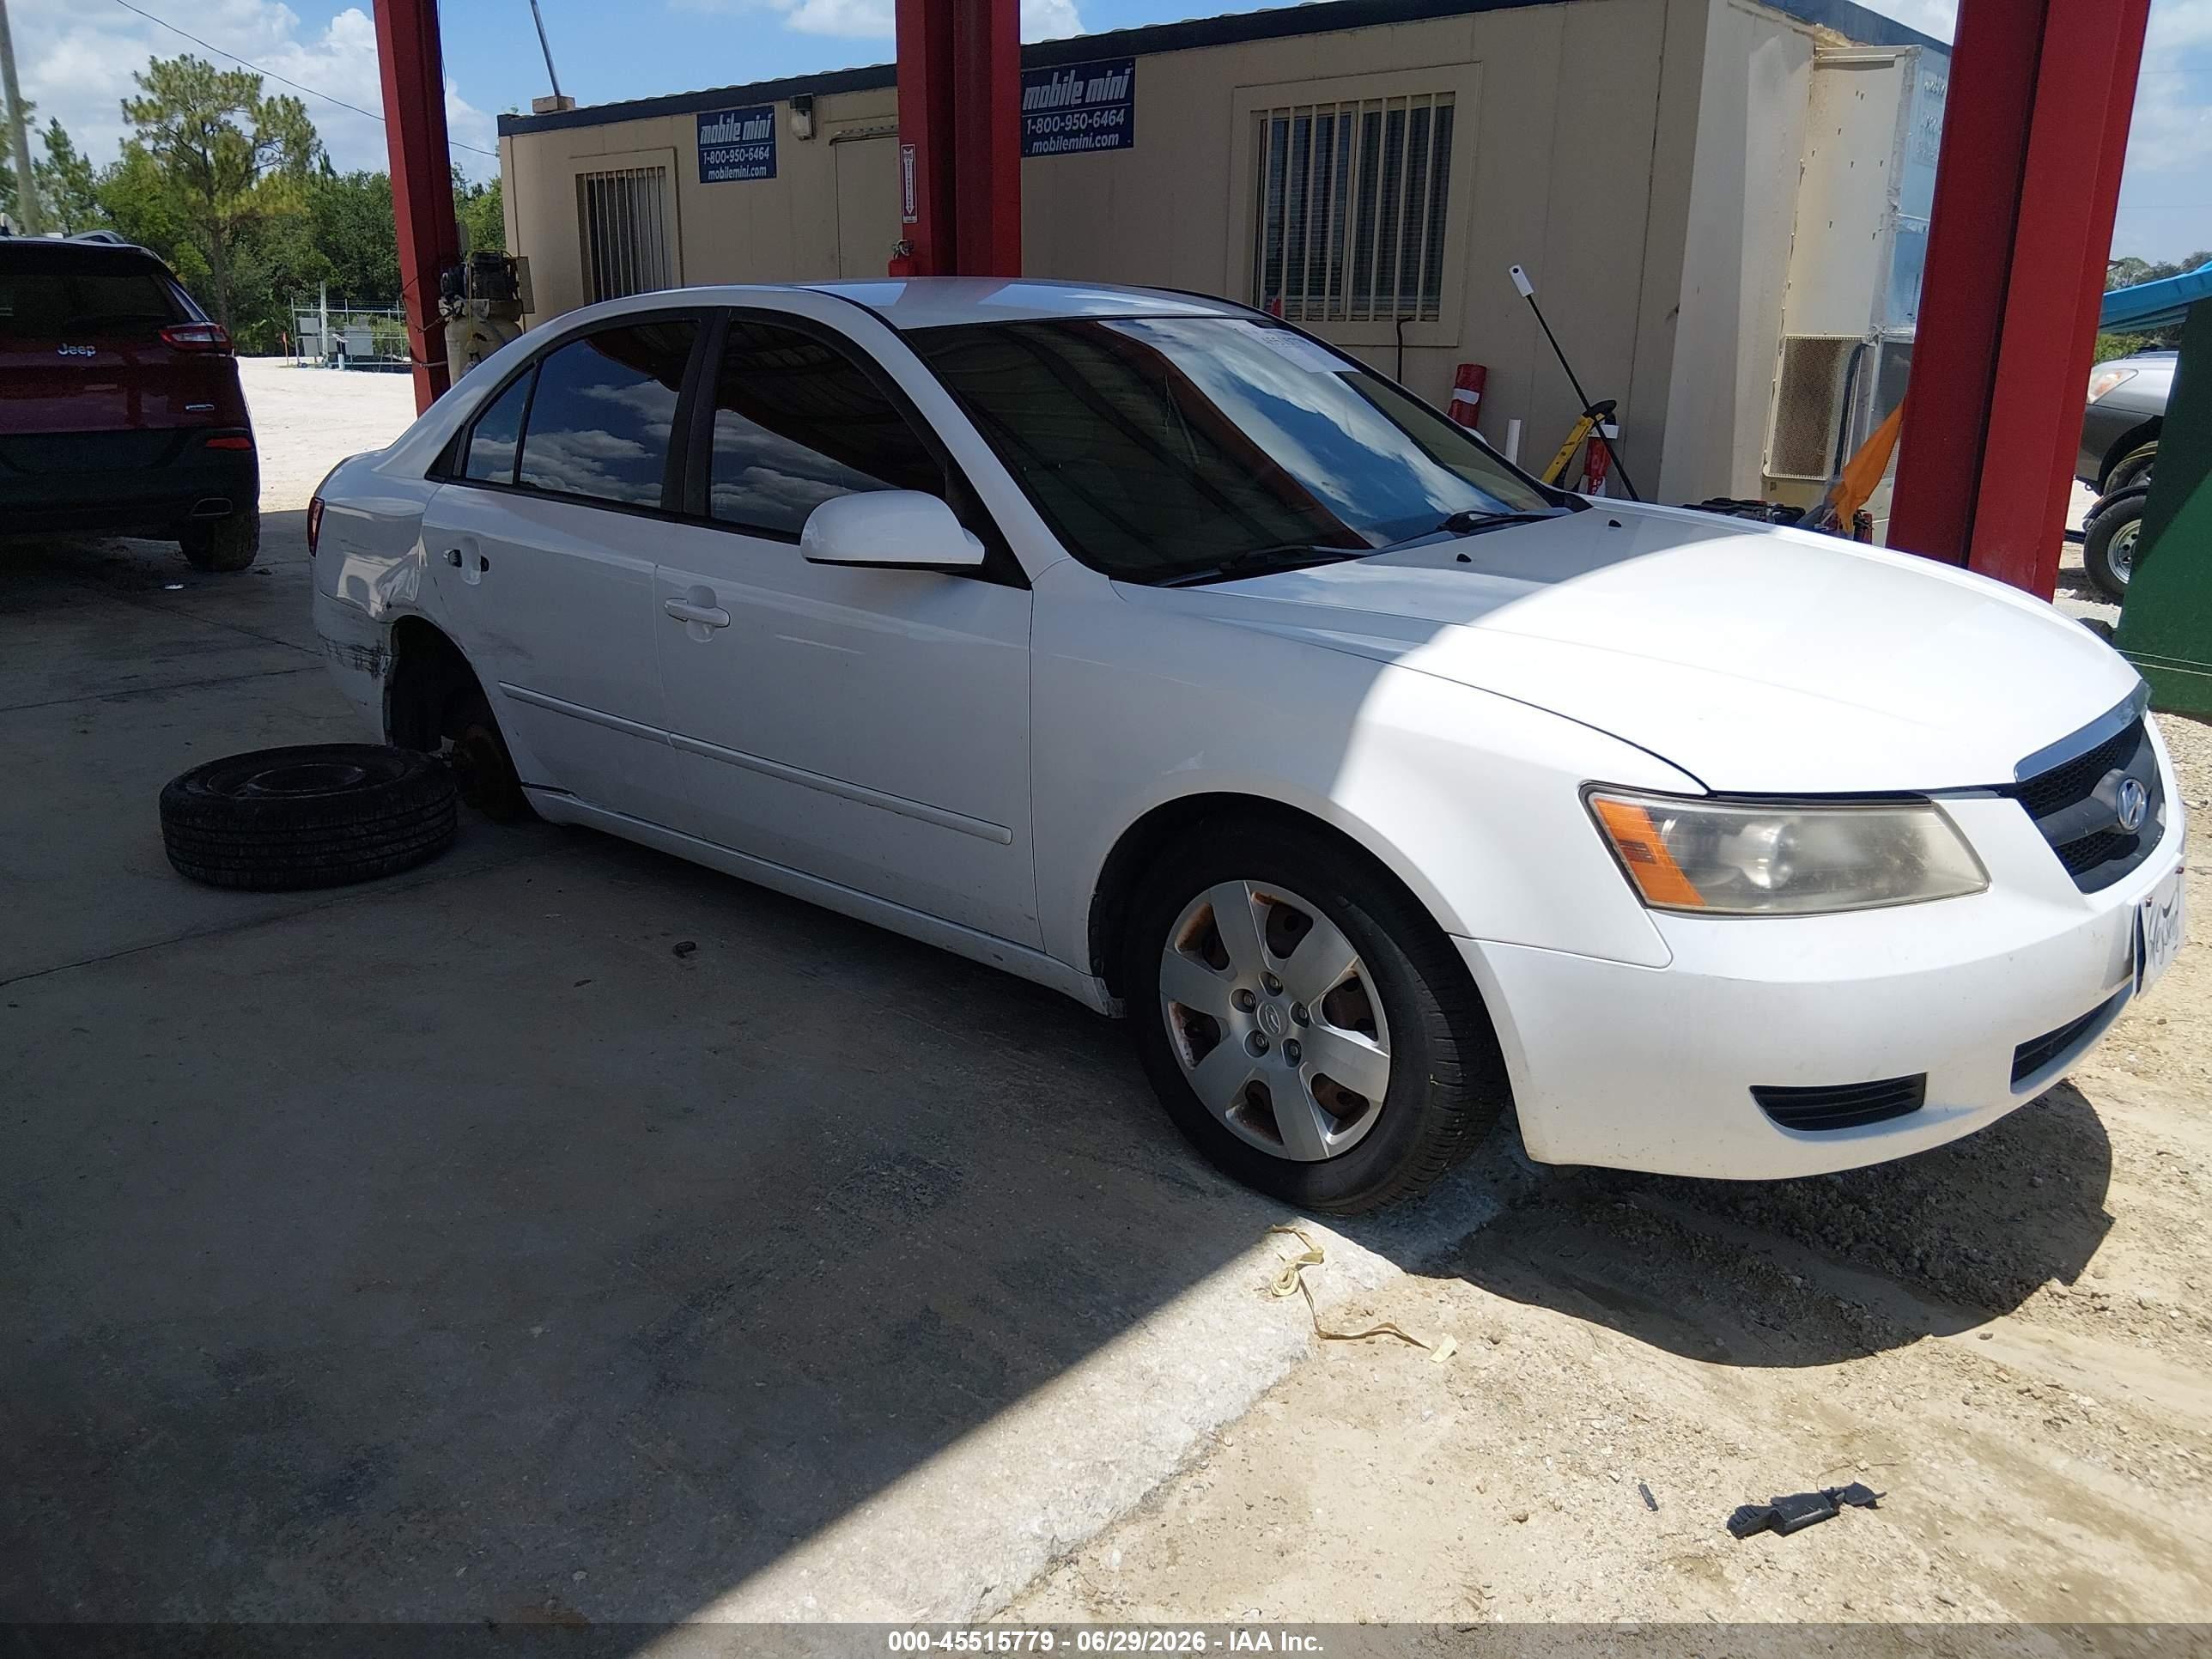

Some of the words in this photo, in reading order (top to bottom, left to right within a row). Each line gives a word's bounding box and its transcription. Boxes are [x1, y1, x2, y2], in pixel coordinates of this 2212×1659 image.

[1022, 70, 1085, 110] mobile
[1085, 68, 1132, 103] mini
[700, 112, 741, 144] mobile
[742, 113, 772, 141] mini
[1027, 108, 1126, 135] 1-800-950-6464
[1032, 132, 1120, 154] mobilemini.com
[703, 146, 770, 165] 1-800-950-6464
[708, 164, 767, 180] mobilemini.com
[57, 343, 96, 357] Jeep
